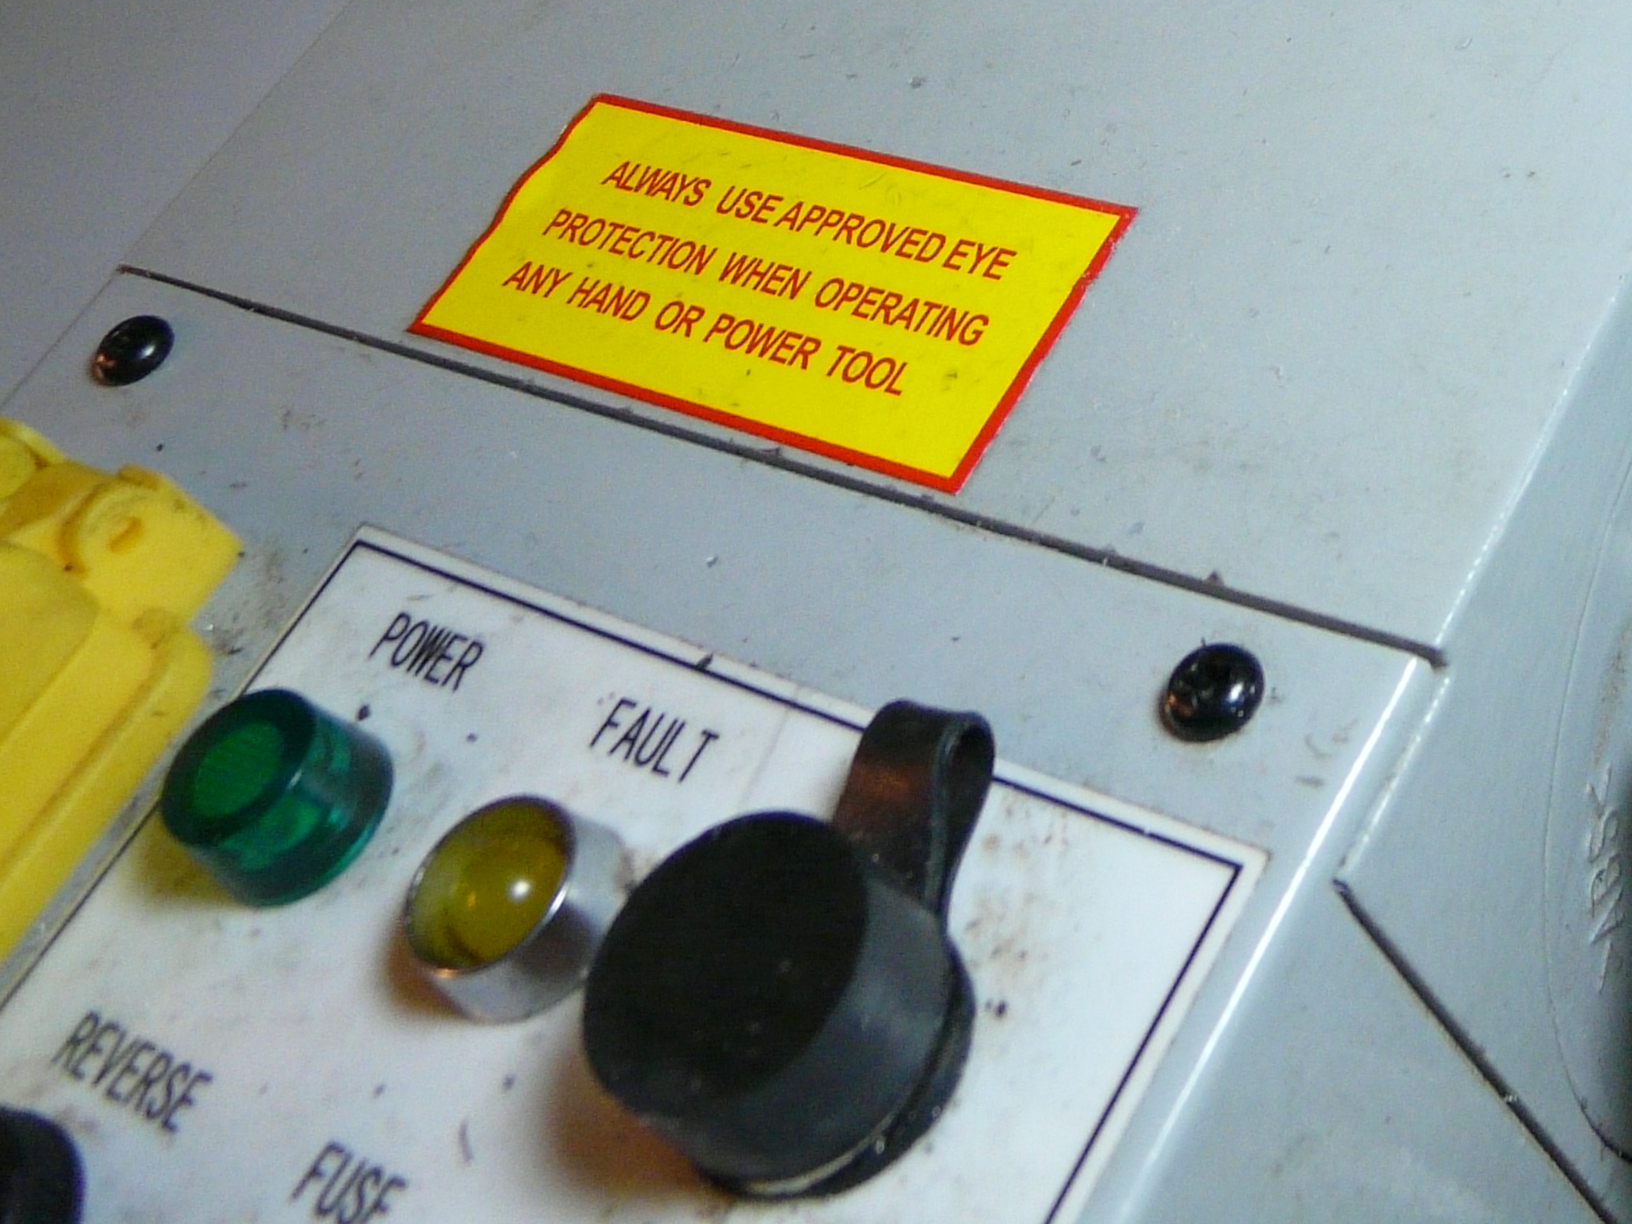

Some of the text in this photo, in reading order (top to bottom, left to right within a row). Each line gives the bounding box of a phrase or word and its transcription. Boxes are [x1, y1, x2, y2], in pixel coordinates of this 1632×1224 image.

[542, 209, 989, 346] PROTECTION WHEN OPERATING
[601, 161, 1017, 280] ALWAYS USE APPROVED EYE
[502, 262, 907, 396] ANY HAND OR POWER TOOL
[370, 613, 483, 691] POWER
[590, 698, 719, 782] FAULT
[52, 1012, 211, 1132] REVERSE
